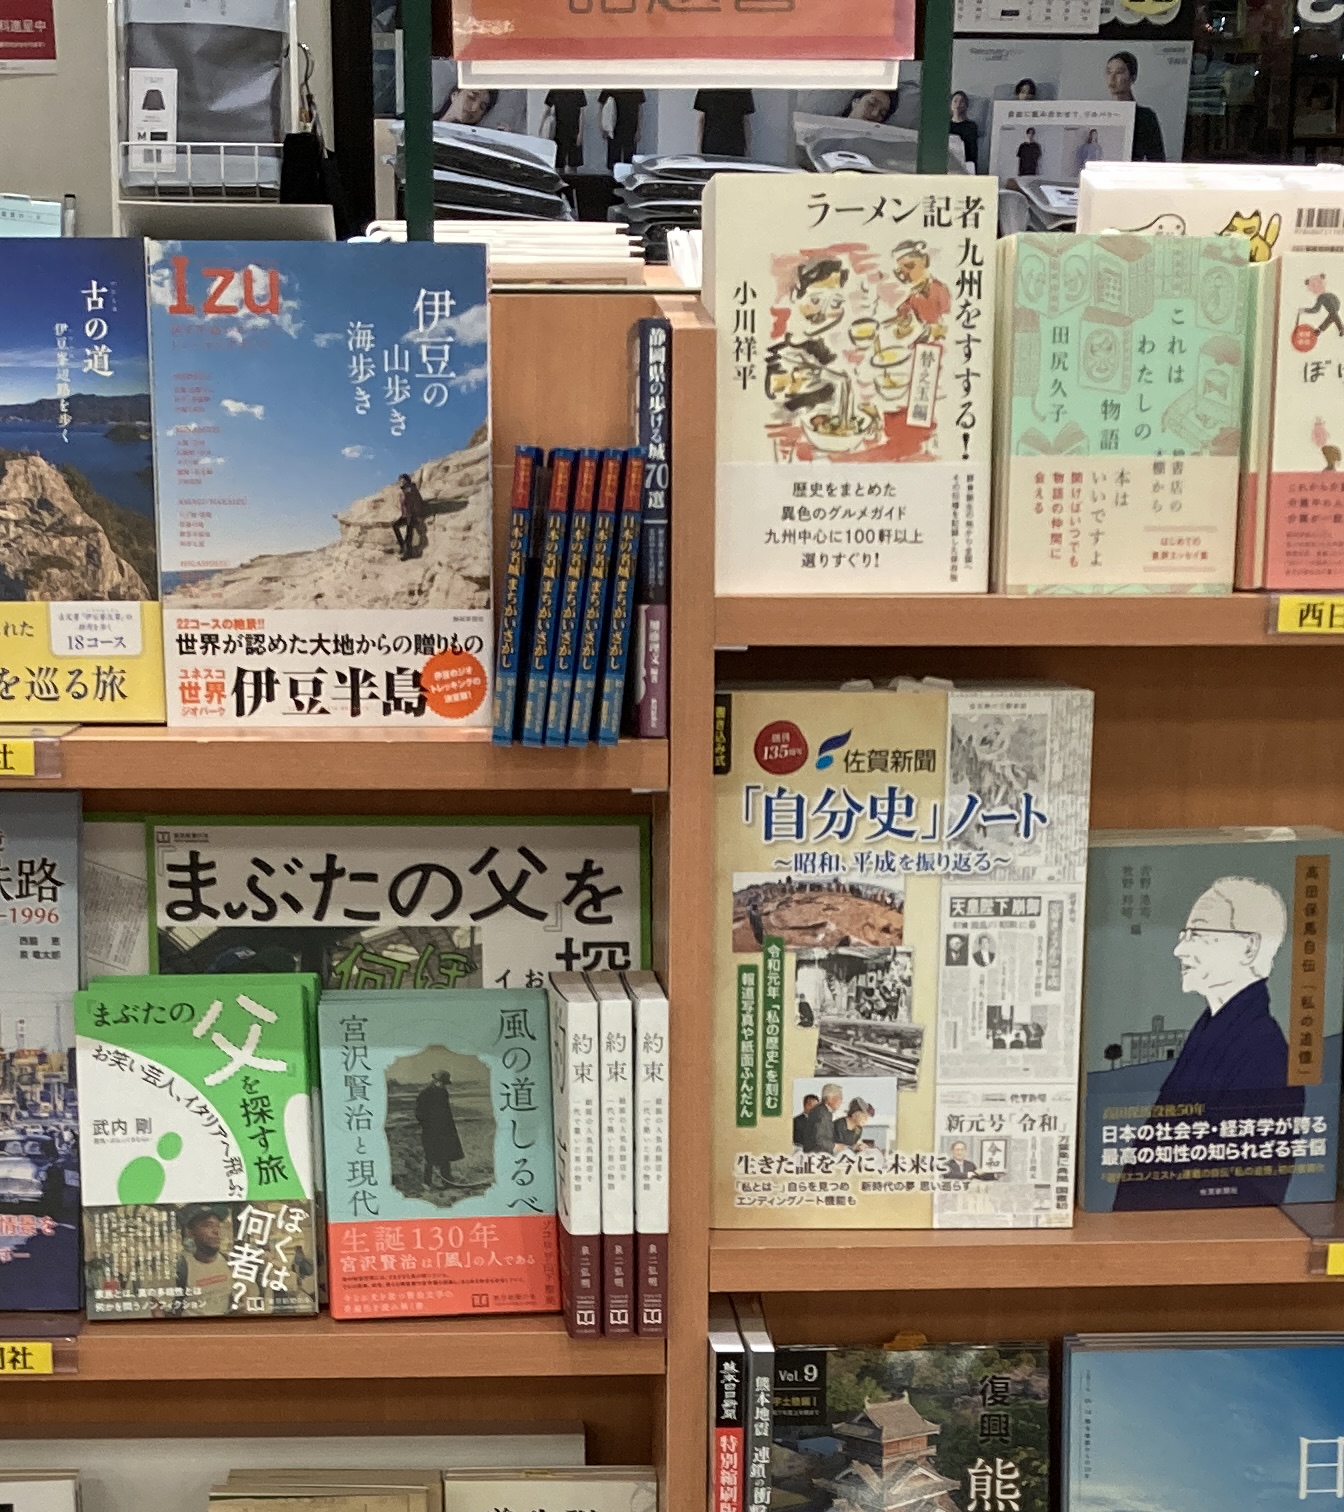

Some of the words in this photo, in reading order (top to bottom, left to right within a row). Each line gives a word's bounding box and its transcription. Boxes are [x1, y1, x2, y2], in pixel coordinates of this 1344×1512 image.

[806, 193, 985, 232] ラーメン記者
[169, 255, 281, 319] Izu
[78, 278, 115, 379] 古の道
[413, 287, 456, 410] 伊豆の
[732, 280, 756, 390] 小川祥平
[954, 237, 985, 462] 九州をすする!
[1167, 306, 1187, 385] これは
[346, 320, 377, 416] 海歩き
[381, 343, 410, 436] 山歩き
[1049, 326, 1069, 423] 田尻久子
[1133, 335, 1156, 442] わたしの
[646, 324, 670, 512] 静岡県の歩ける城70選
[1098, 398, 1121, 451] 物語
[782, 506, 907, 521] 異色のグルメガイド
[792, 481, 897, 498] 歴史をまとめた
[764, 528, 924, 544] 九州中心に100軒以上
[801, 552, 880, 568] 選りすぐり!
[175, 632, 485, 657] 世界が認めた大地からの贈りもの
[178, 681, 227, 704] 世界
[233, 665, 429, 718] 伊豆半島
[843, 748, 936, 774] 佐賀新聞
[743, 786, 1049, 842] 「自分史」ノート
[571, 1032, 594, 1084] 約束
[605, 1031, 628, 1083] 約束
[642, 1031, 666, 1084] 約束
[92, 1118, 130, 1136] 武内
[137, 1117, 153, 1136] 剛
[239, 1075, 290, 1187] を探す旅
[340, 1014, 381, 1218] 宮沢賢治と現代
[497, 1006, 544, 1215] 風の道しるべ
[1101, 1118, 1328, 1145] 日本の社会学・経済学が誇る
[737, 1153, 949, 1176] 生きた証を今に、未来に
[1101, 1140, 1327, 1167] 最高の知性の知られざる苦悩
[227, 1204, 269, 1311] 何者?
[259, 1204, 310, 1294] ぼくは
[340, 1224, 501, 1255] 生誕130年
[340, 1251, 536, 1273] 宮沢賢治は「風」の人である
[978, 1373, 1013, 1445] 復興
